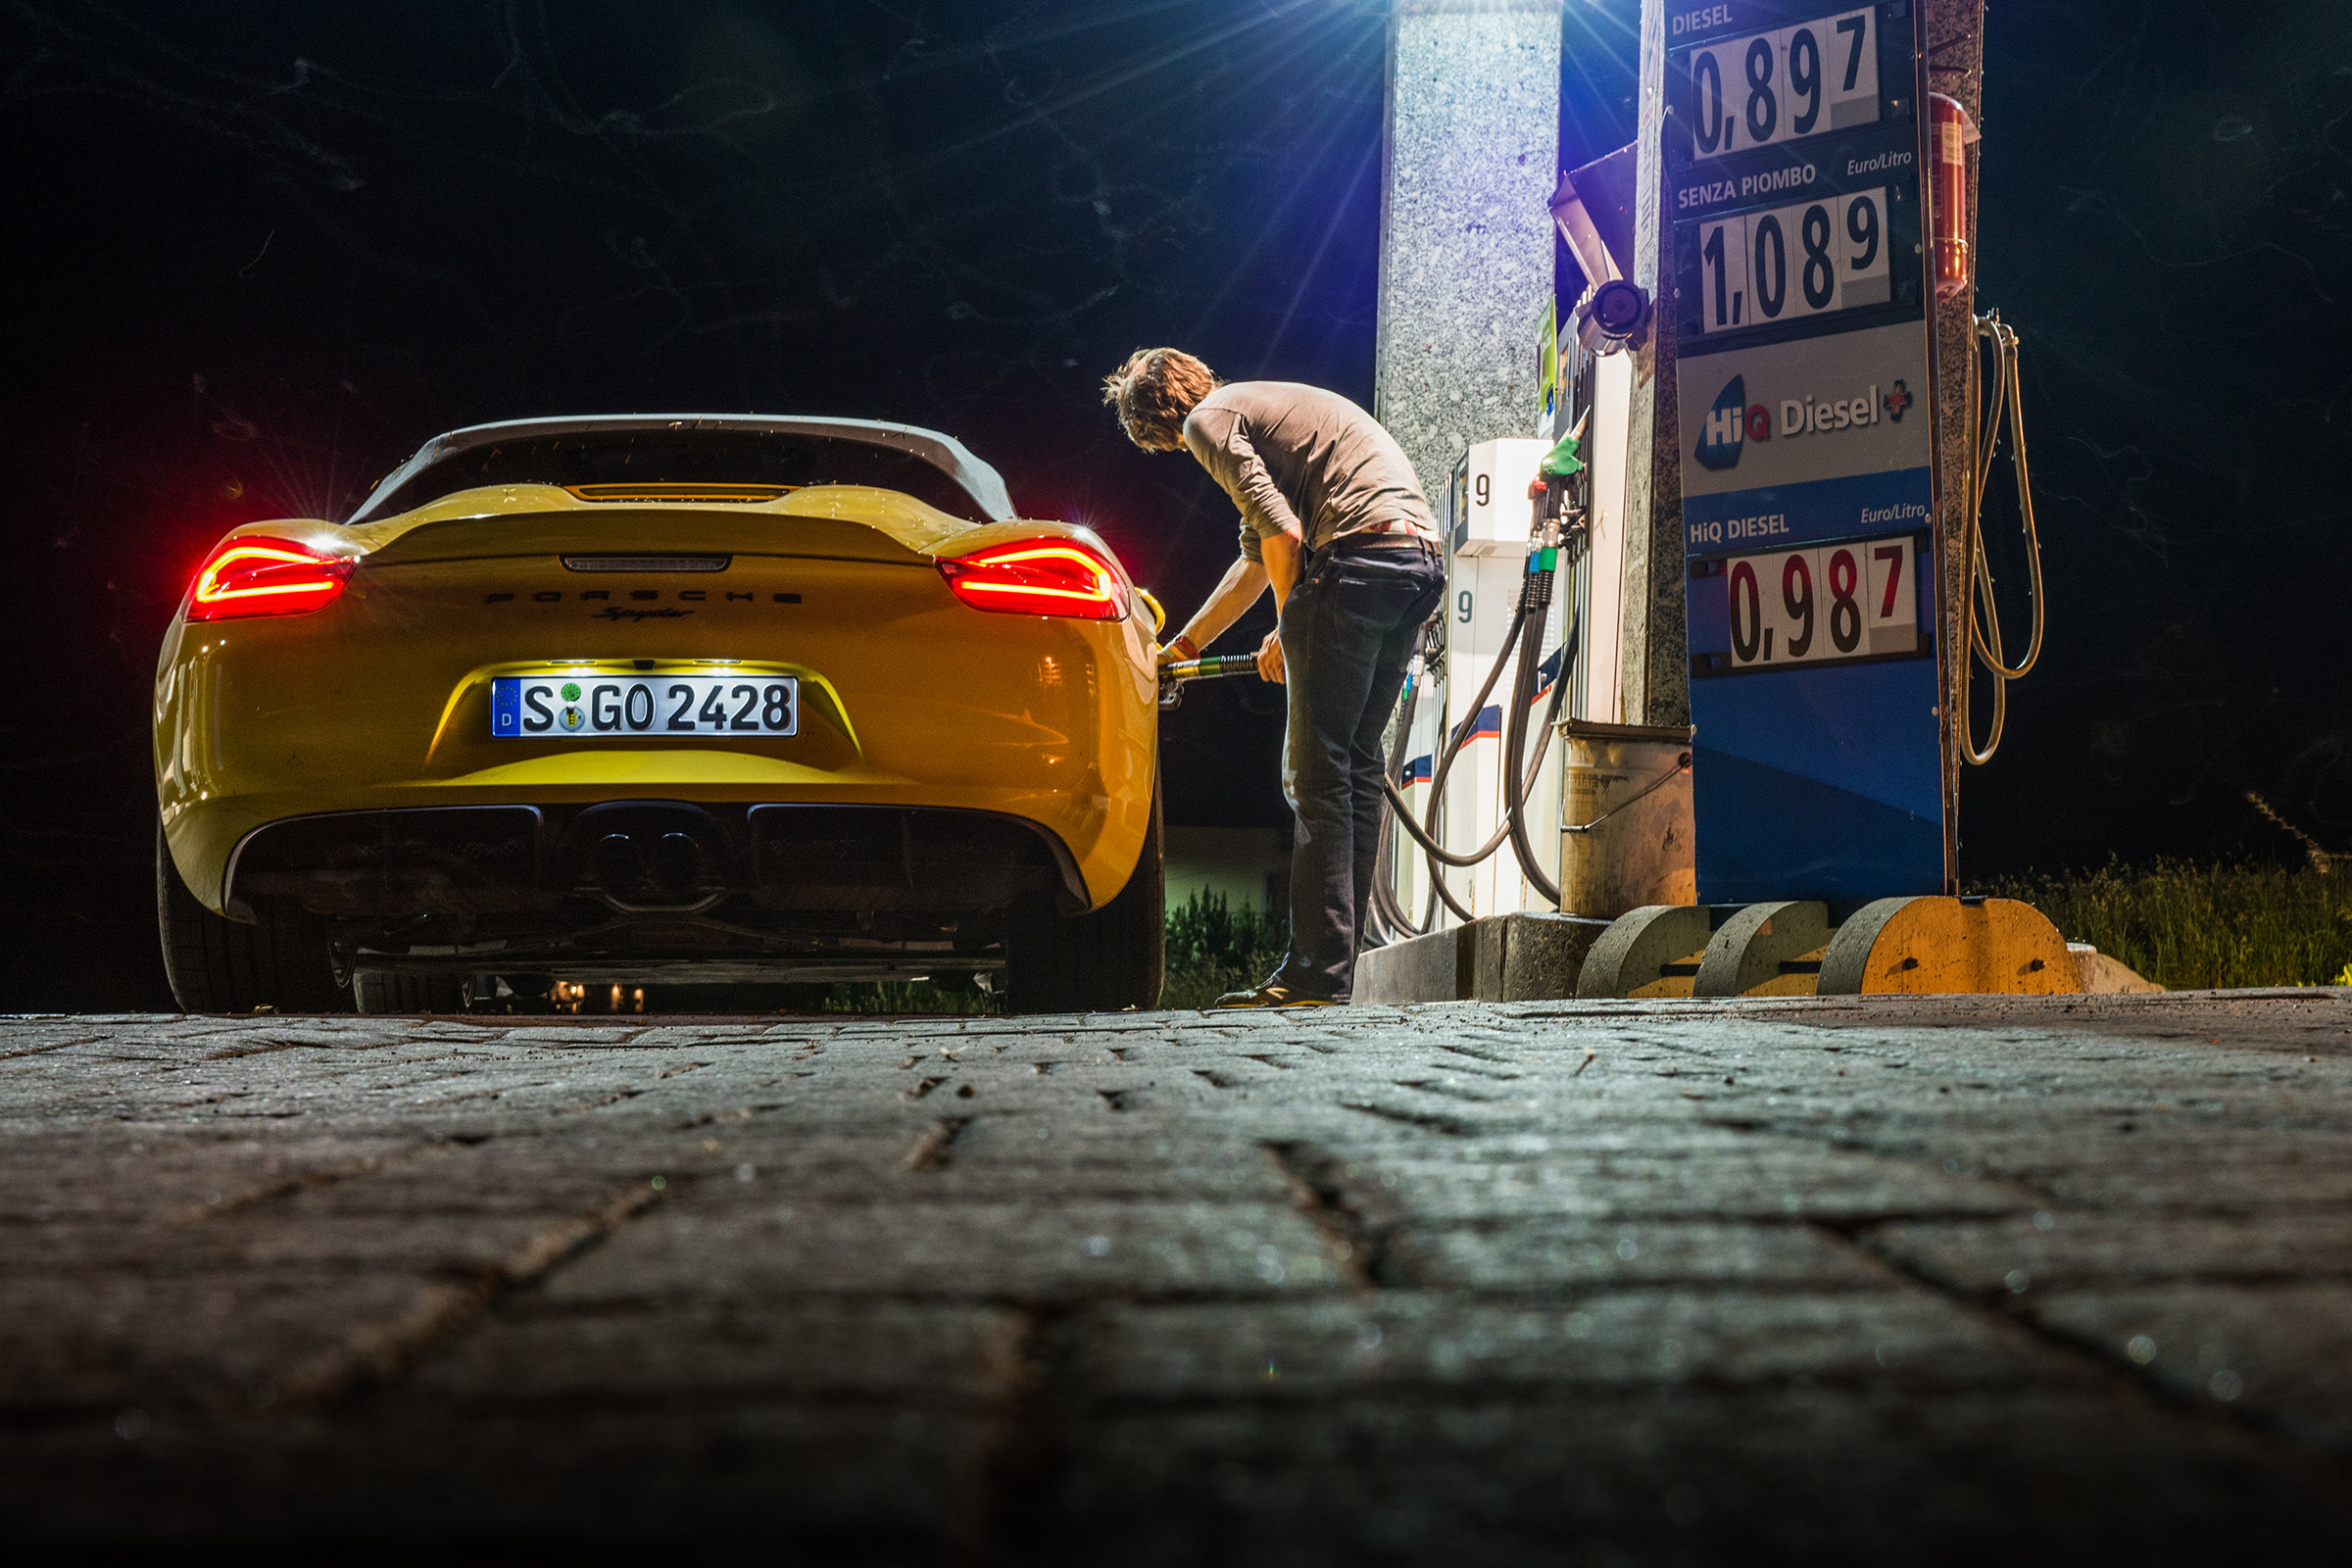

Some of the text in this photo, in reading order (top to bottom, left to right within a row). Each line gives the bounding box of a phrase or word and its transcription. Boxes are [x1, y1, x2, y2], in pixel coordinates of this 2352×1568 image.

[1672, 5, 1733, 35] DIESEL
[1692, 15, 1866, 155] 0,897
[1847, 151, 1911, 175] Euro/Litro
[1678, 164, 1816, 209] SENZA PIOMBO
[1703, 195, 1879, 327] 1,089
[1706, 403, 1771, 447] HiQ
[1475, 473, 1491, 507] 9
[1690, 514, 1789, 544] HiQ DIESEL
[1861, 504, 1925, 524] Euro/Litro
[484, 590, 802, 605] PORSCHE
[1457, 590, 1473, 623] 9
[1730, 545, 1903, 662] 0,987
[501, 712, 512, 726] D
[523, 684, 792, 732] S GO 2428
